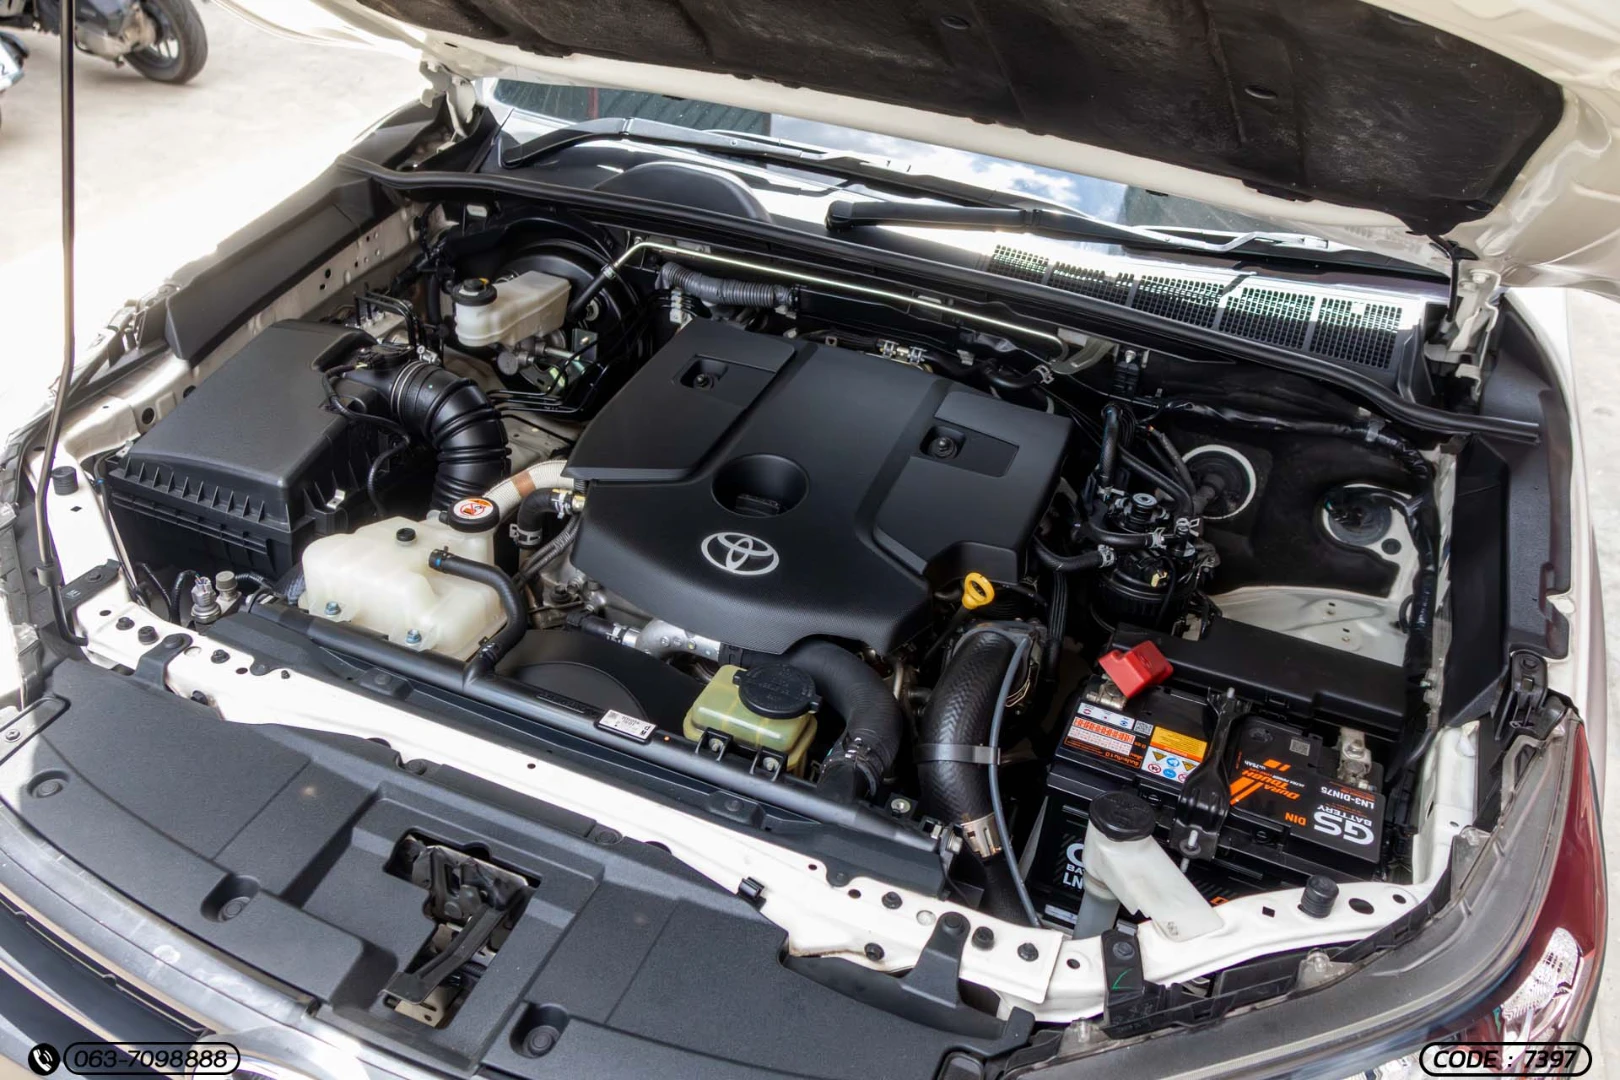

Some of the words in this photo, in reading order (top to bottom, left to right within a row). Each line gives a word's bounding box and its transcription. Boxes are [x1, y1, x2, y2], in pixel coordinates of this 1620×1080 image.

[1242, 769, 1289, 790] TOUGH
[1263, 784, 1300, 800] DURA
[1321, 786, 1375, 810] LN3-DIN75
[1285, 812, 1307, 827] DIN
[1317, 804, 1372, 827] BATTERY
[1313, 811, 1375, 845] GS
[1066, 863, 1085, 875] BA
